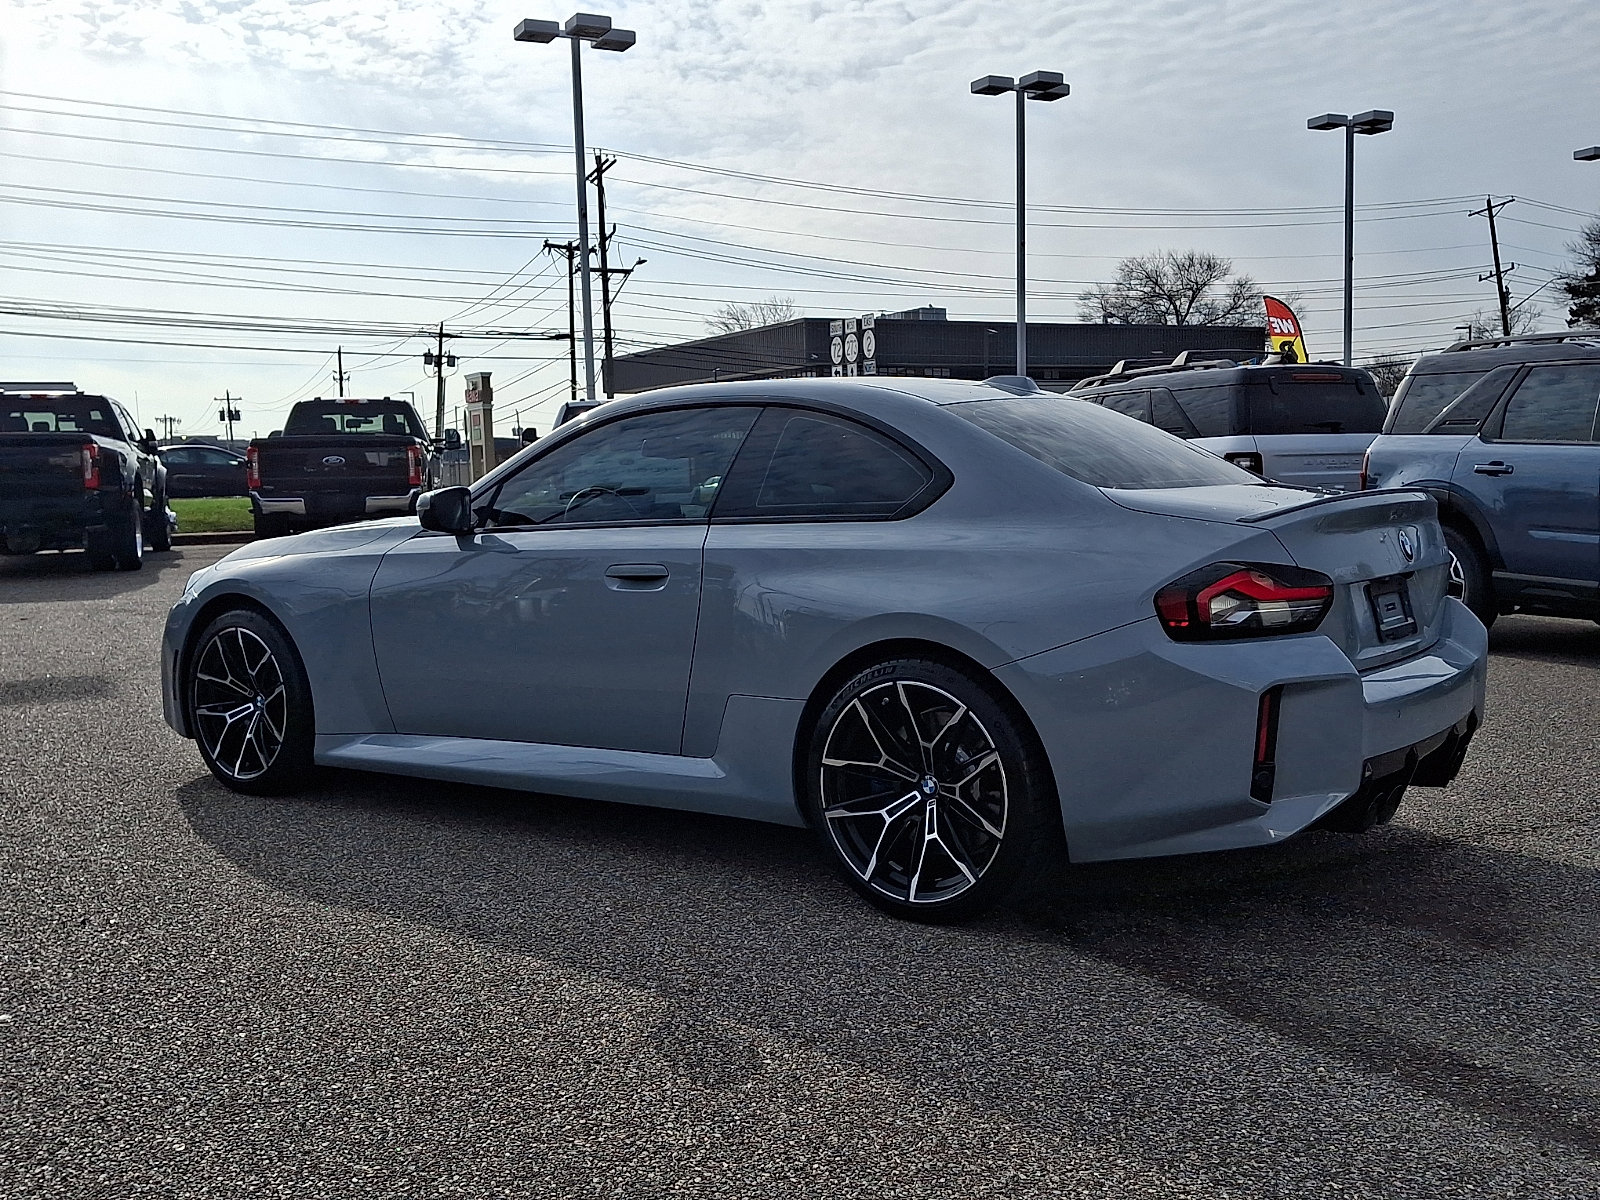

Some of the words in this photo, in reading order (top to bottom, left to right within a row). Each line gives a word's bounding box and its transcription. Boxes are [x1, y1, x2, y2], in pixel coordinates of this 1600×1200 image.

[832, 342, 842, 358] 72
[846, 339, 857, 356] 273
[866, 336, 872, 352] 2
[842, 667, 894, 698] MICHELIN
